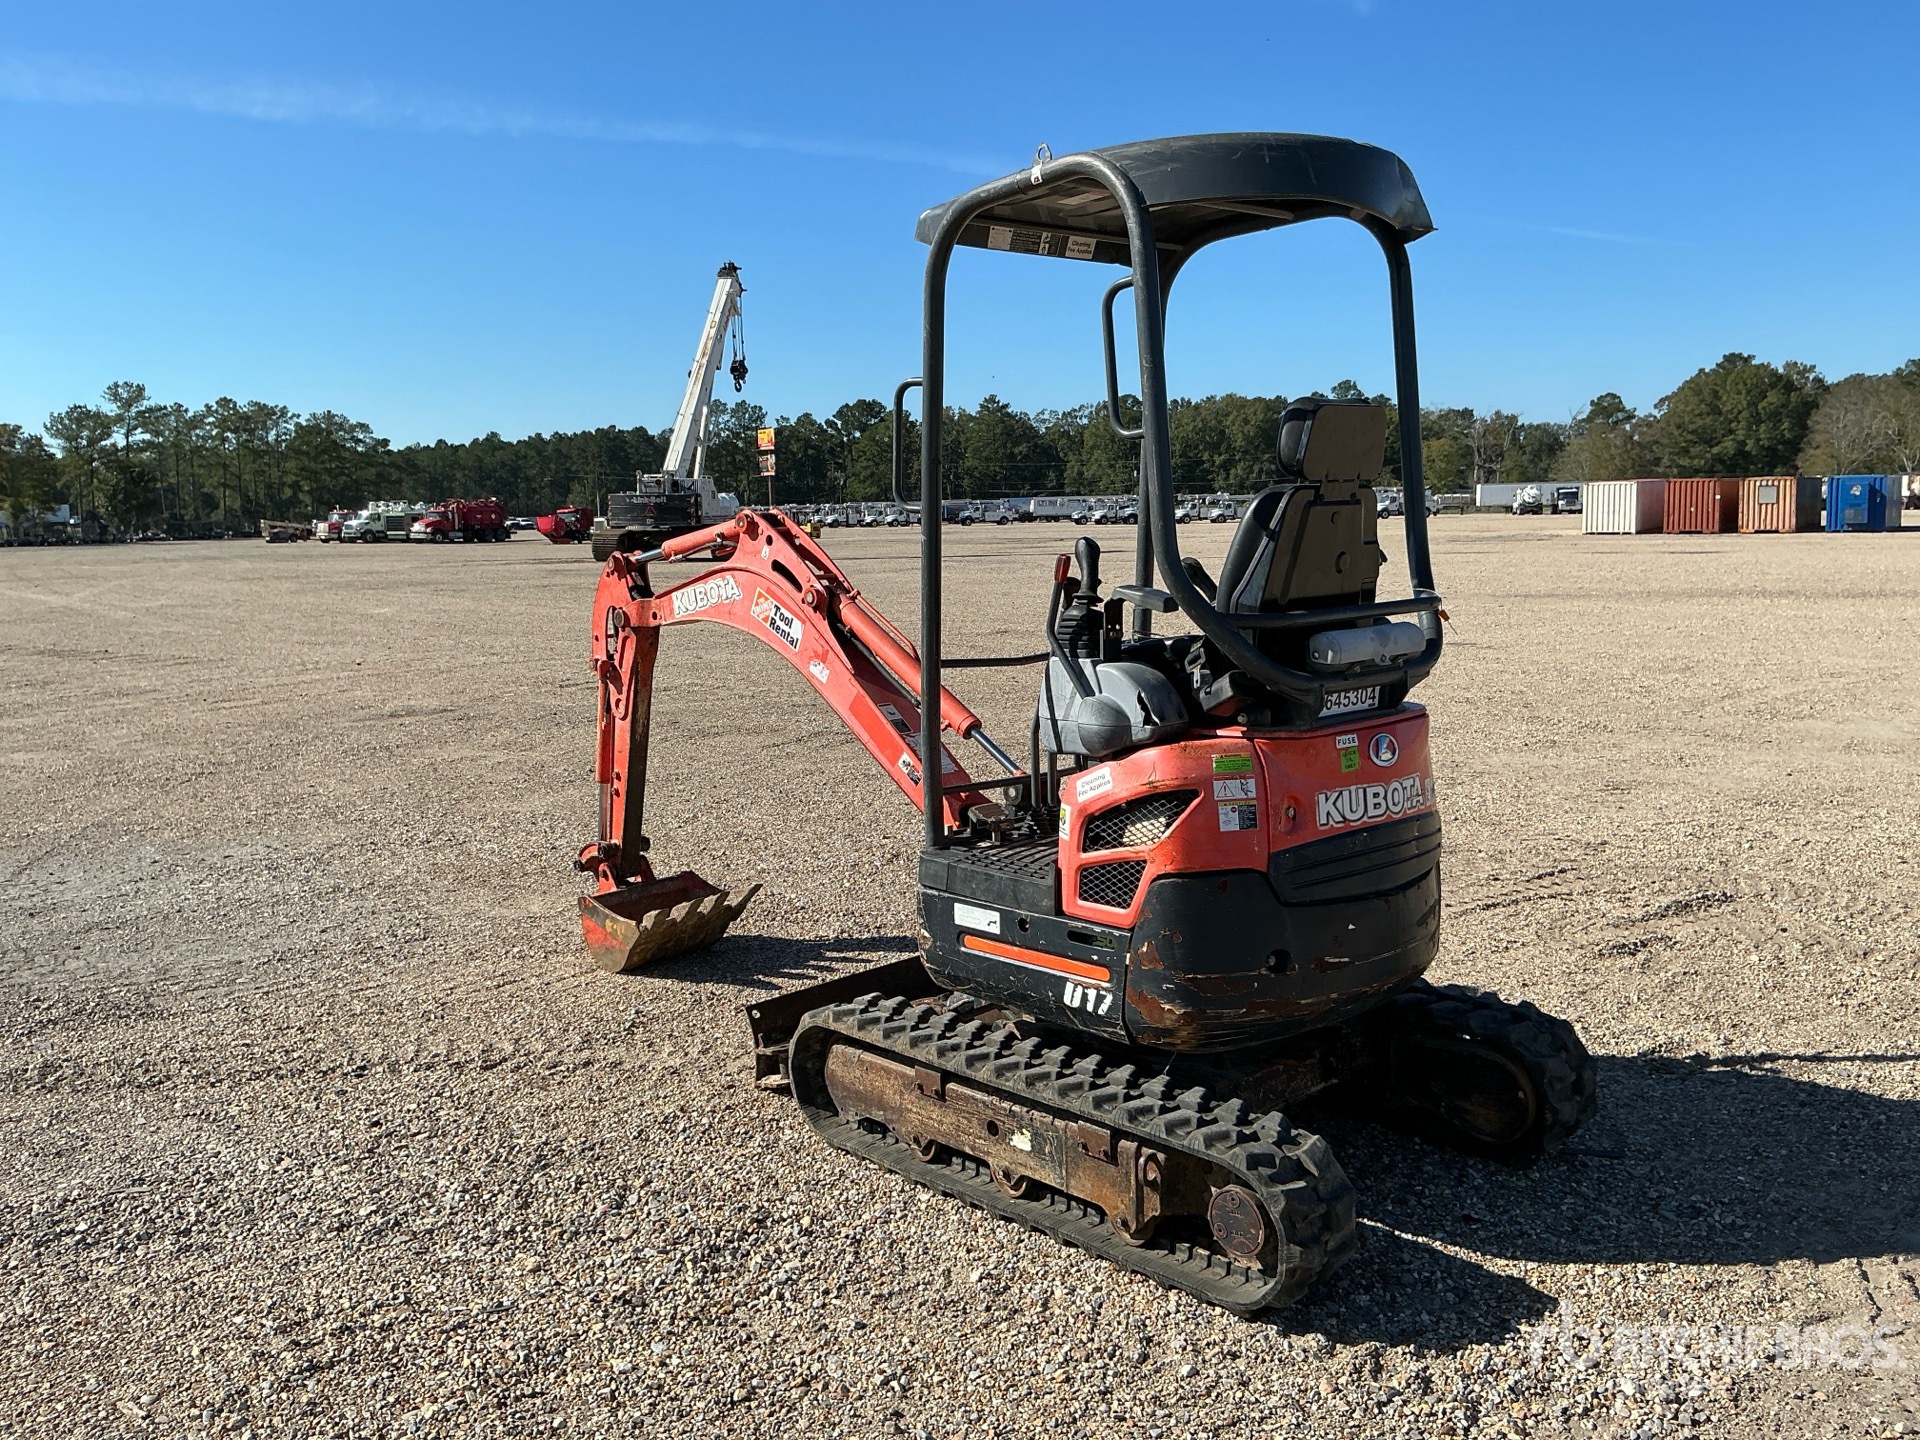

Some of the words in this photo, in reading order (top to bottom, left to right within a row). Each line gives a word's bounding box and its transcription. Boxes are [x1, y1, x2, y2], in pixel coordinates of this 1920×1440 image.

[672, 575, 742, 617] KUBOTA
[769, 616, 799, 650] Rental
[773, 604, 794, 629] Tool
[1337, 736, 1356, 746] FUSE
[1081, 773, 1106, 788] Cleaning
[1316, 774, 1424, 829] KUBOTA
[1063, 981, 1113, 1015] U17
